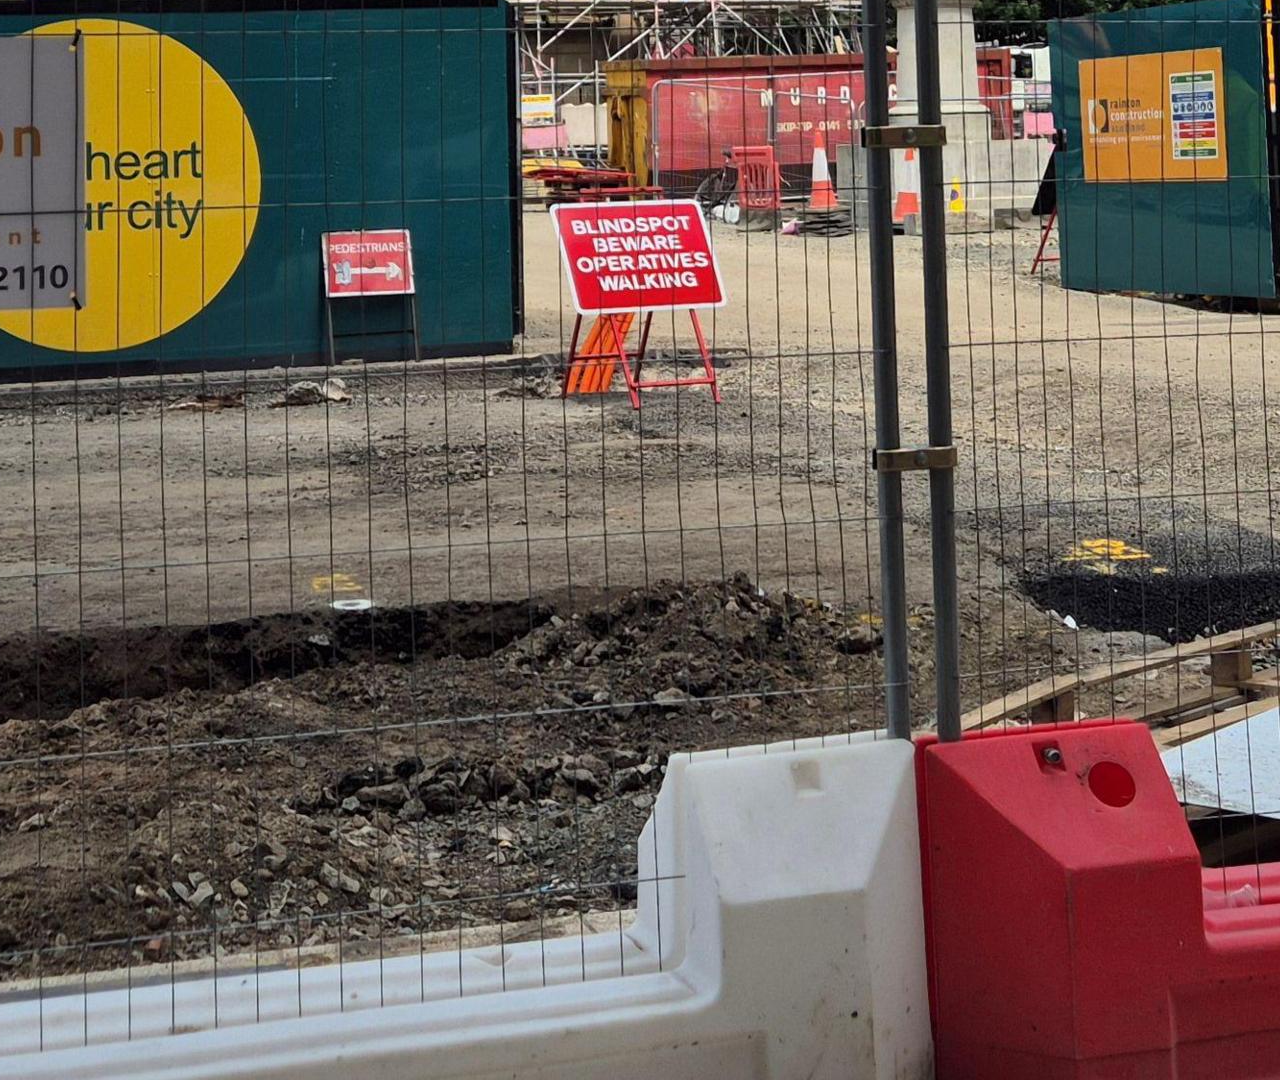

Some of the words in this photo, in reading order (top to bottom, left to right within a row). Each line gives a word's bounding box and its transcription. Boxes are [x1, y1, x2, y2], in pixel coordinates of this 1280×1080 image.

[1110, 107, 1165, 121] contruction
[85, 140, 203, 181] heart
[127, 189, 204, 239] city
[570, 215, 690, 235] BLINDSPOT
[329, 242, 405, 254] PEDESTRIANS
[592, 234, 684, 253] BEWARE
[576, 251, 709, 274] OPERATIVES
[596, 271, 699, 292] WALKING
